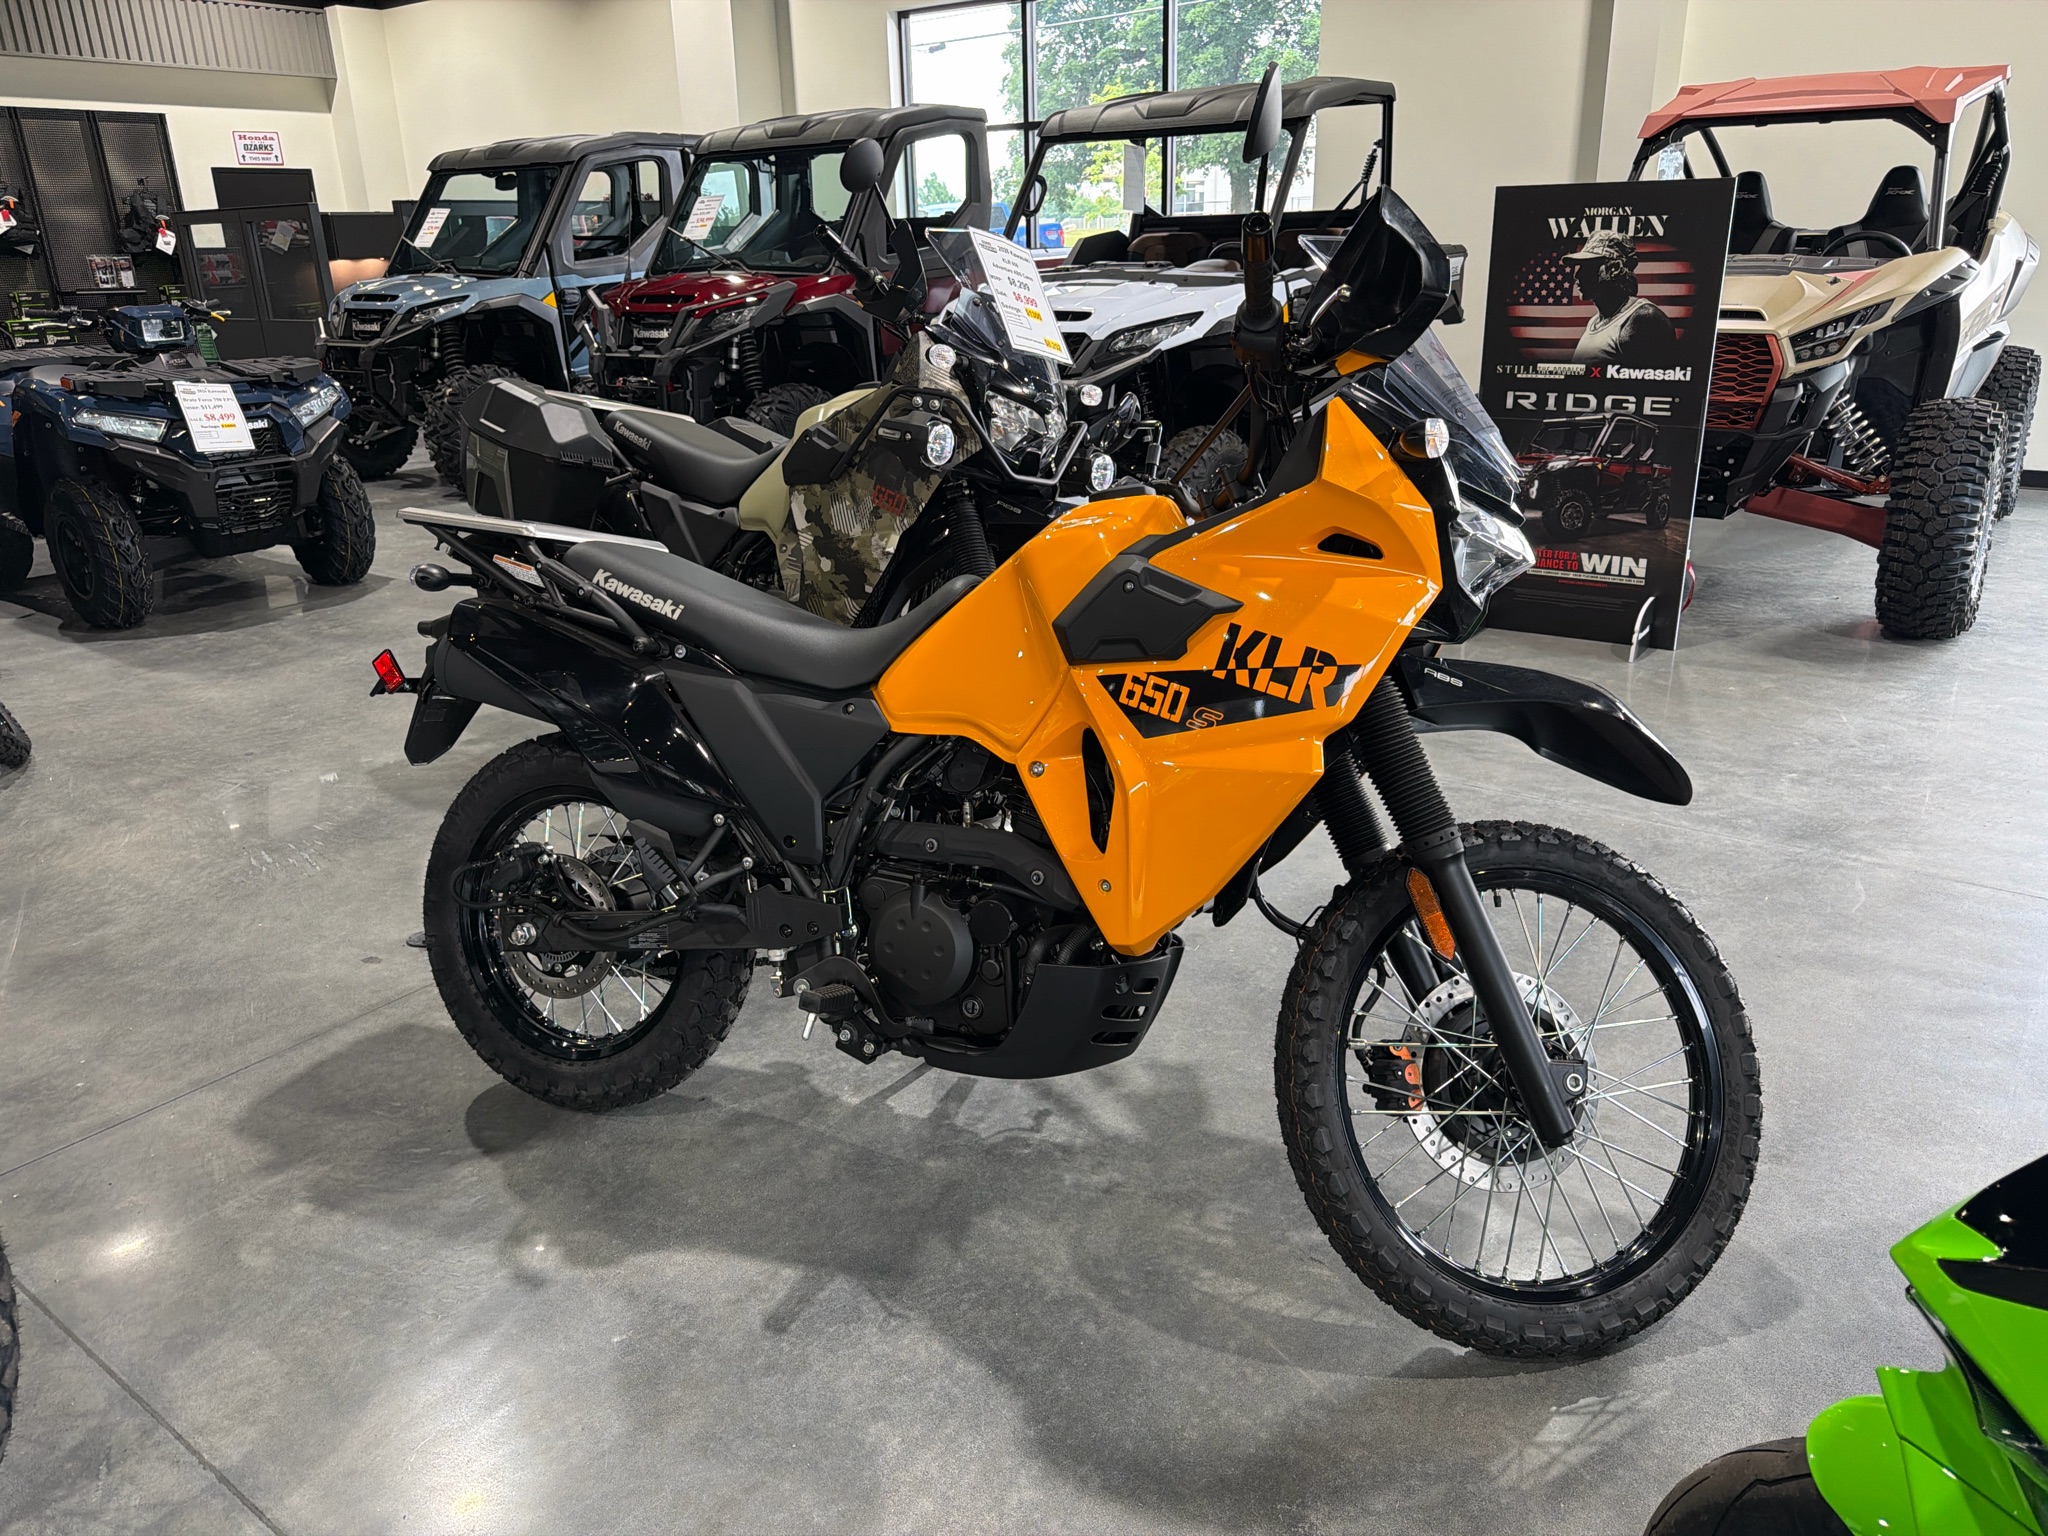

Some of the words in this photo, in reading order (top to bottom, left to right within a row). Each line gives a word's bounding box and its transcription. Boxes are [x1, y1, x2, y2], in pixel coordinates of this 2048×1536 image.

[243, 144, 274, 152] OZARKS
[1584, 206, 1632, 216] MORGAN
[1547, 214, 1670, 240] WALLEN
[1012, 291, 1038, 308] $6,999
[1496, 365, 1535, 374] STILL
[1538, 366, 1550, 374] THE
[1553, 366, 1585, 376] PROBLEM
[1606, 365, 1692, 381] Kawasaki
[1506, 390, 1672, 416] RIDGE
[204, 413, 235, 422] $8,499
[247, 419, 268, 430] saki
[613, 420, 652, 451] Kawasaki
[1534, 548, 1553, 558] TER
[1554, 550, 1570, 560] FOR
[1572, 552, 1578, 560] A
[1536, 558, 1564, 569] ANCE
[1567, 560, 1579, 570] TO
[1580, 553, 1648, 578] WIN
[592, 568, 685, 621] Kawasaki
[1212, 622, 1338, 709] KLR
[1424, 667, 1463, 687] ABS
[1119, 672, 1190, 723] 650
